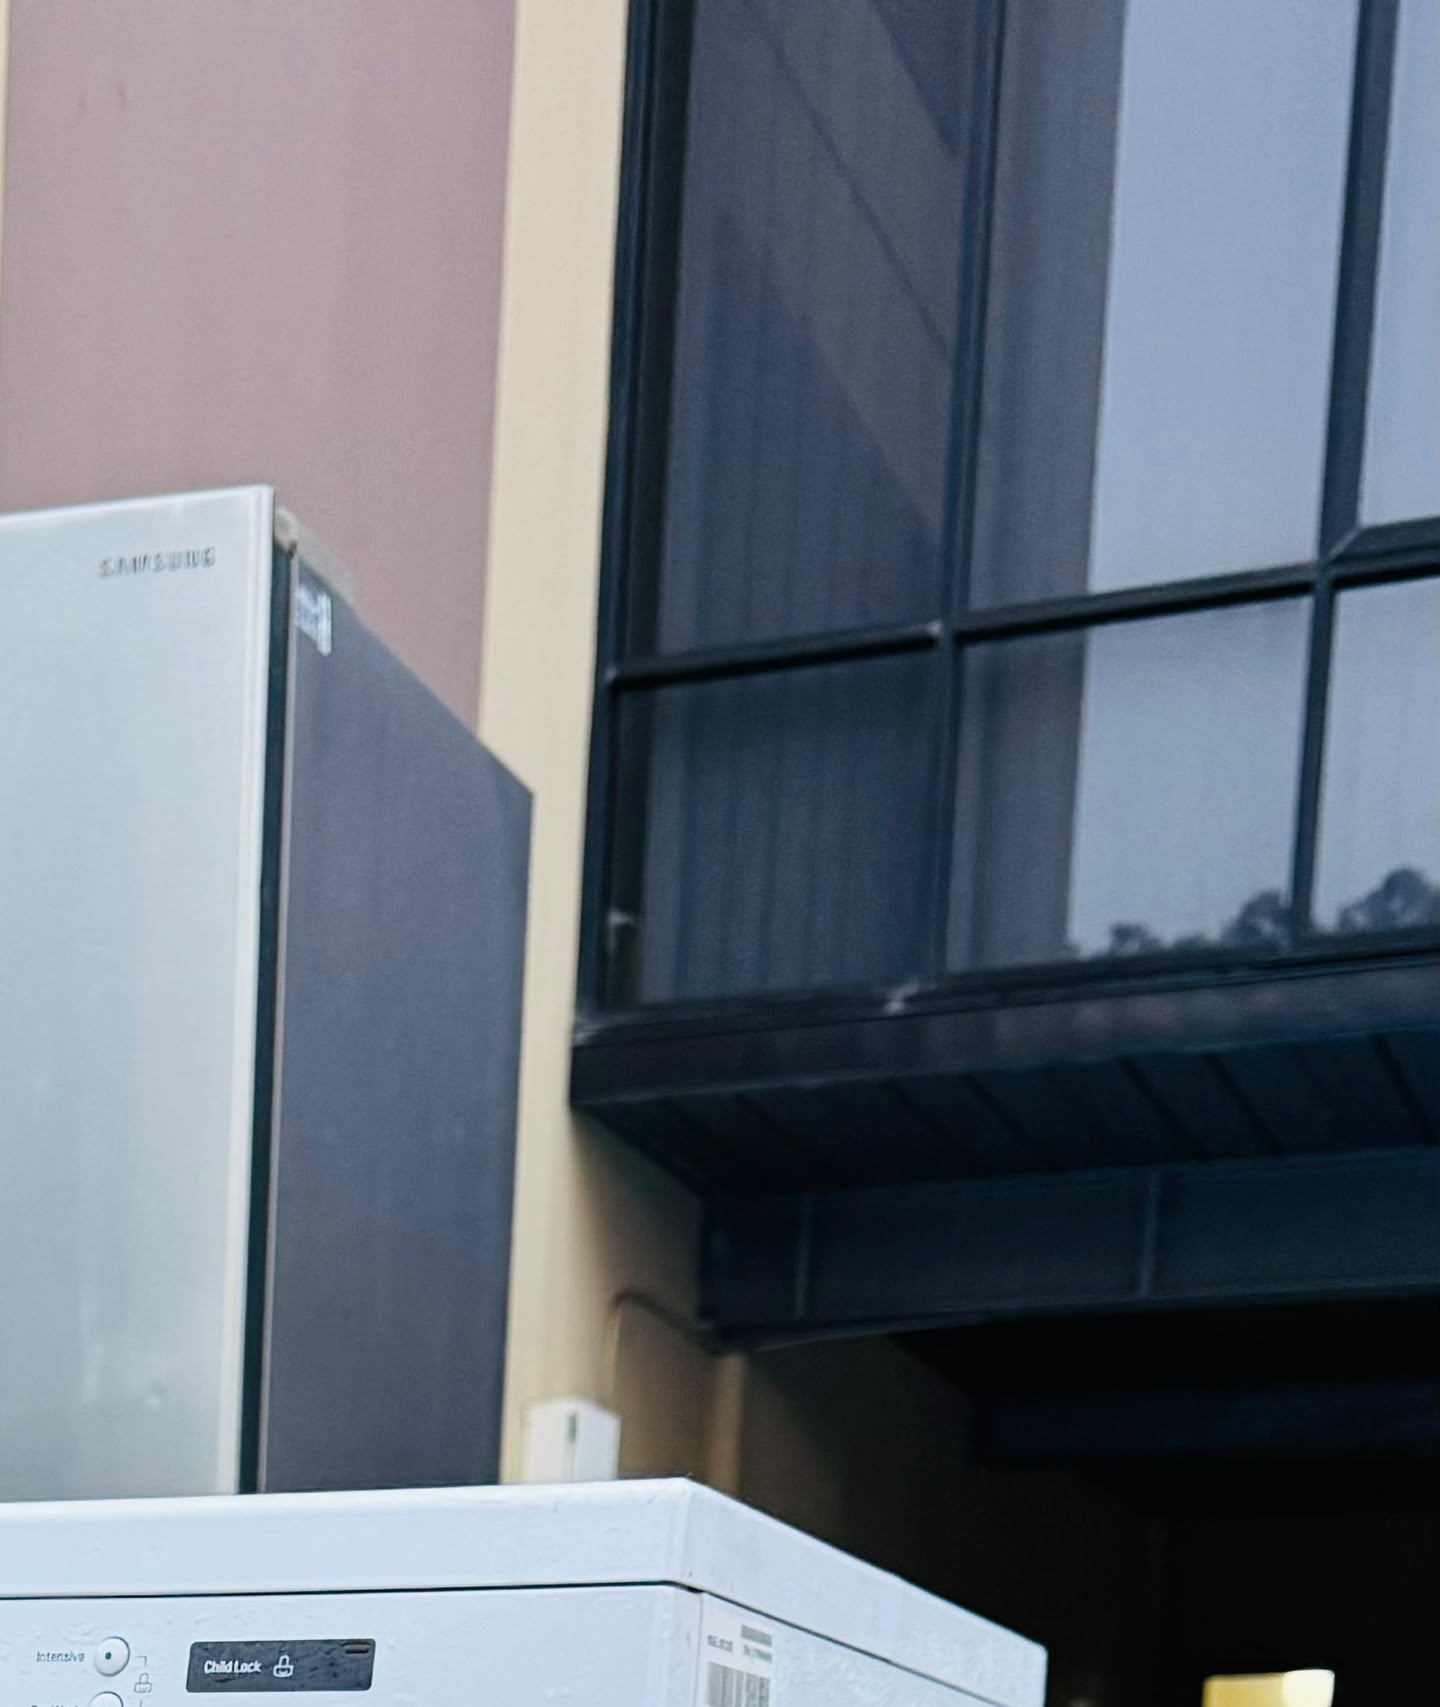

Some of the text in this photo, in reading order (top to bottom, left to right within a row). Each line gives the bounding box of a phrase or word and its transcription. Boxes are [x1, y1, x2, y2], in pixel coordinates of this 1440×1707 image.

[36, 1651, 85, 1662] Intensive
[204, 1660, 262, 1674] Child Lock
